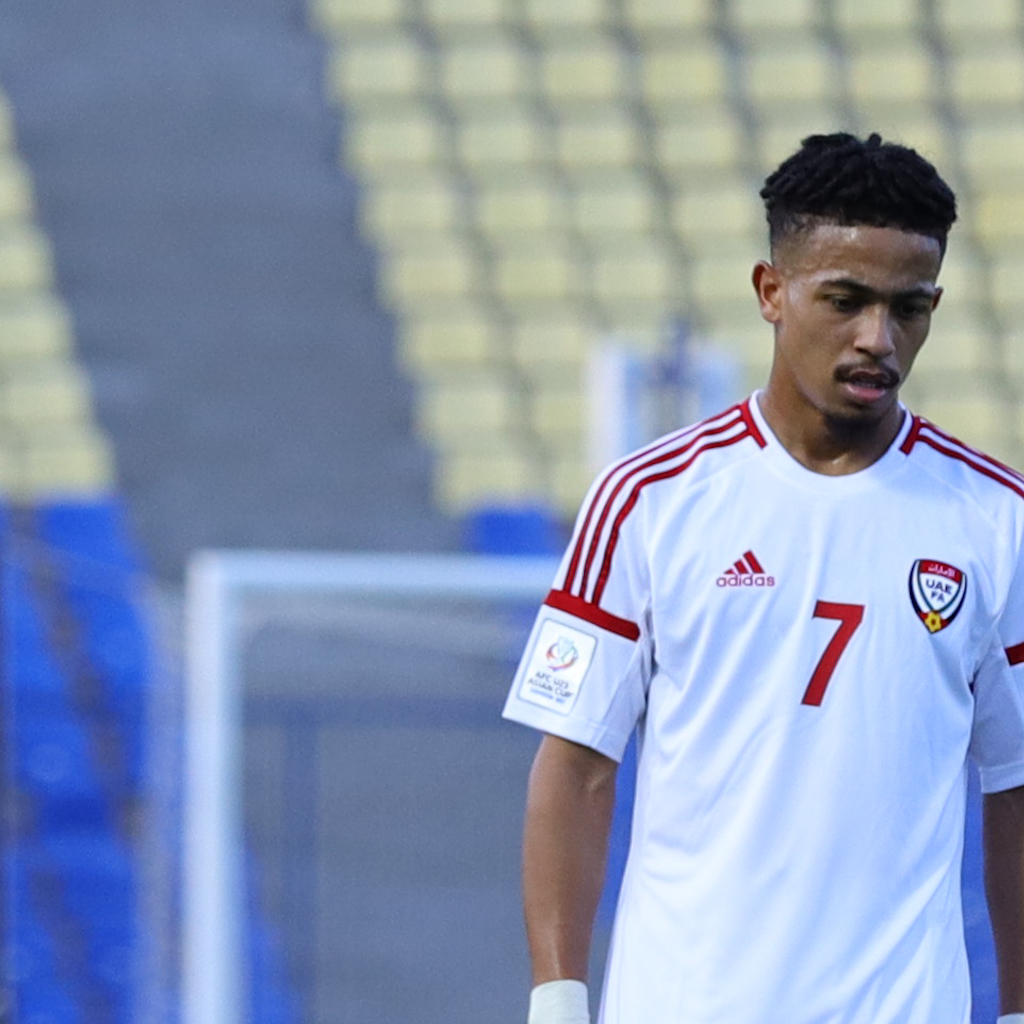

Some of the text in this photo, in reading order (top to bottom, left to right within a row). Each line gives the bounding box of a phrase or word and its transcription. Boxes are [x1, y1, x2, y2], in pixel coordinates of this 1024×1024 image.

[716, 575, 775, 587] adidas
[925, 579, 953, 595] UAE
[801, 599, 865, 707] 7
